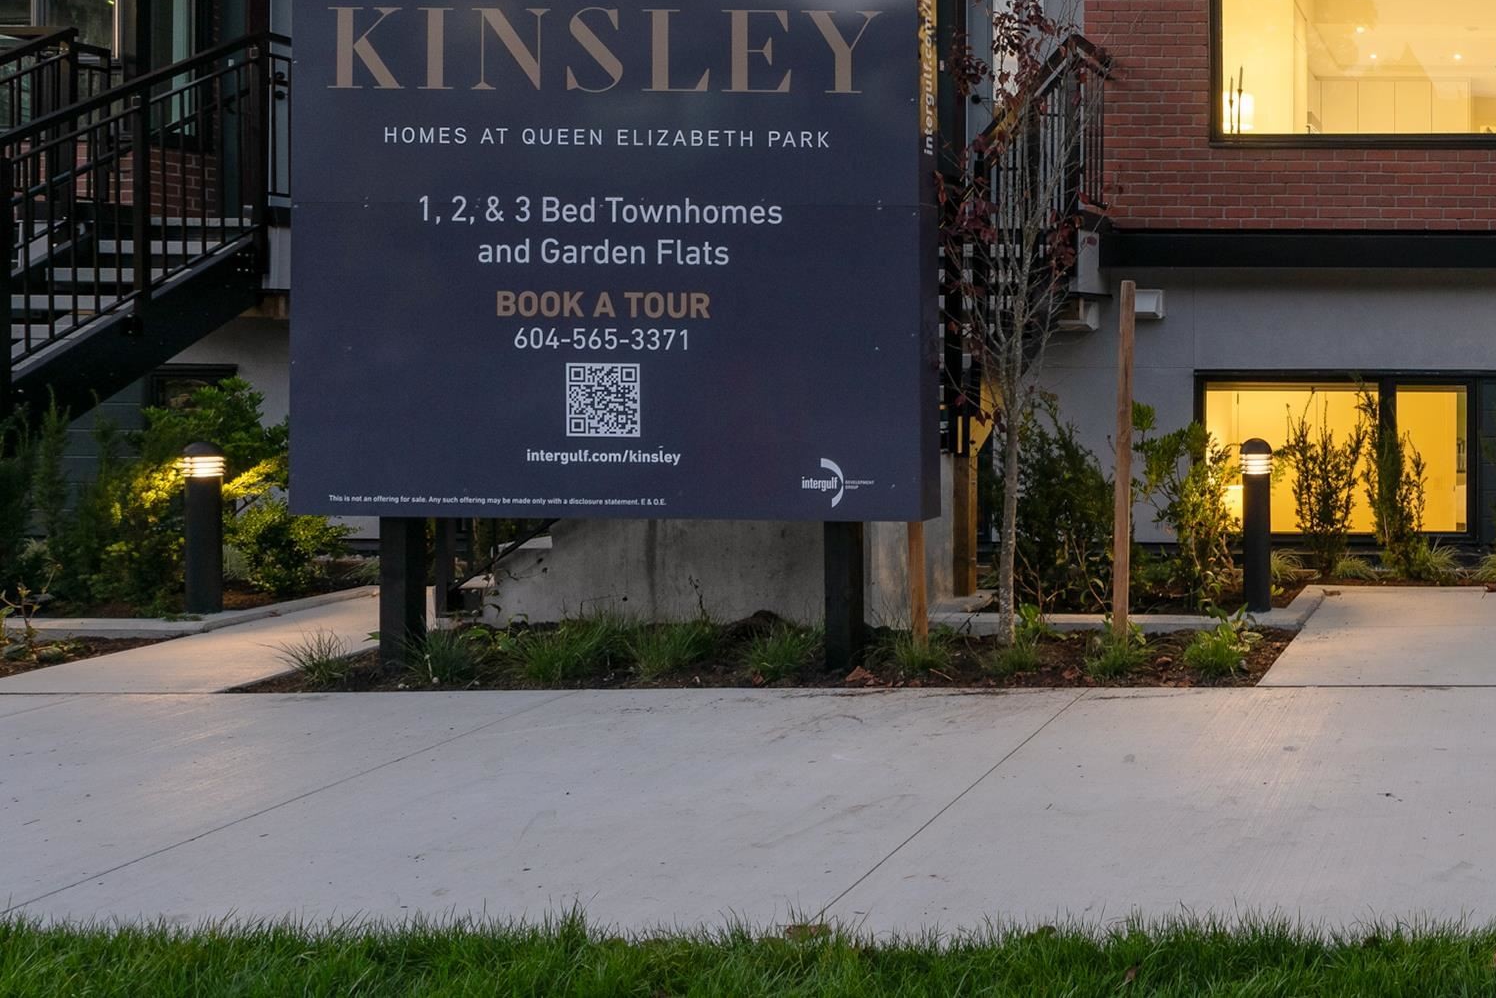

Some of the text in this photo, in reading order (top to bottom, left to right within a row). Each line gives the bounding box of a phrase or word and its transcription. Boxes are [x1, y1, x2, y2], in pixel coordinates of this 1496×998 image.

[327, 6, 883, 95] KINSLEY
[384, 127, 830, 149] HOMES AT QUEEN ELIZABETH PARK
[418, 195, 783, 226] 1, 2, & 3 Bed Townhomes
[477, 238, 730, 267] and Garden Flats
[496, 290, 711, 319] BOOK A TOUR
[513, 328, 690, 351] 604-565-3371
[526, 448, 681, 466] intergulf.com/kinsley
[801, 476, 838, 491] intergulf
[329, 494, 343, 502] This
[373, 495, 400, 504] offering
[428, 496, 441, 504] Any
[442, 496, 459, 504] such
[459, 496, 486, 505] offering
[532, 497, 546, 505] only
[547, 497, 562, 505] with
[569, 498, 603, 506] disclosure
